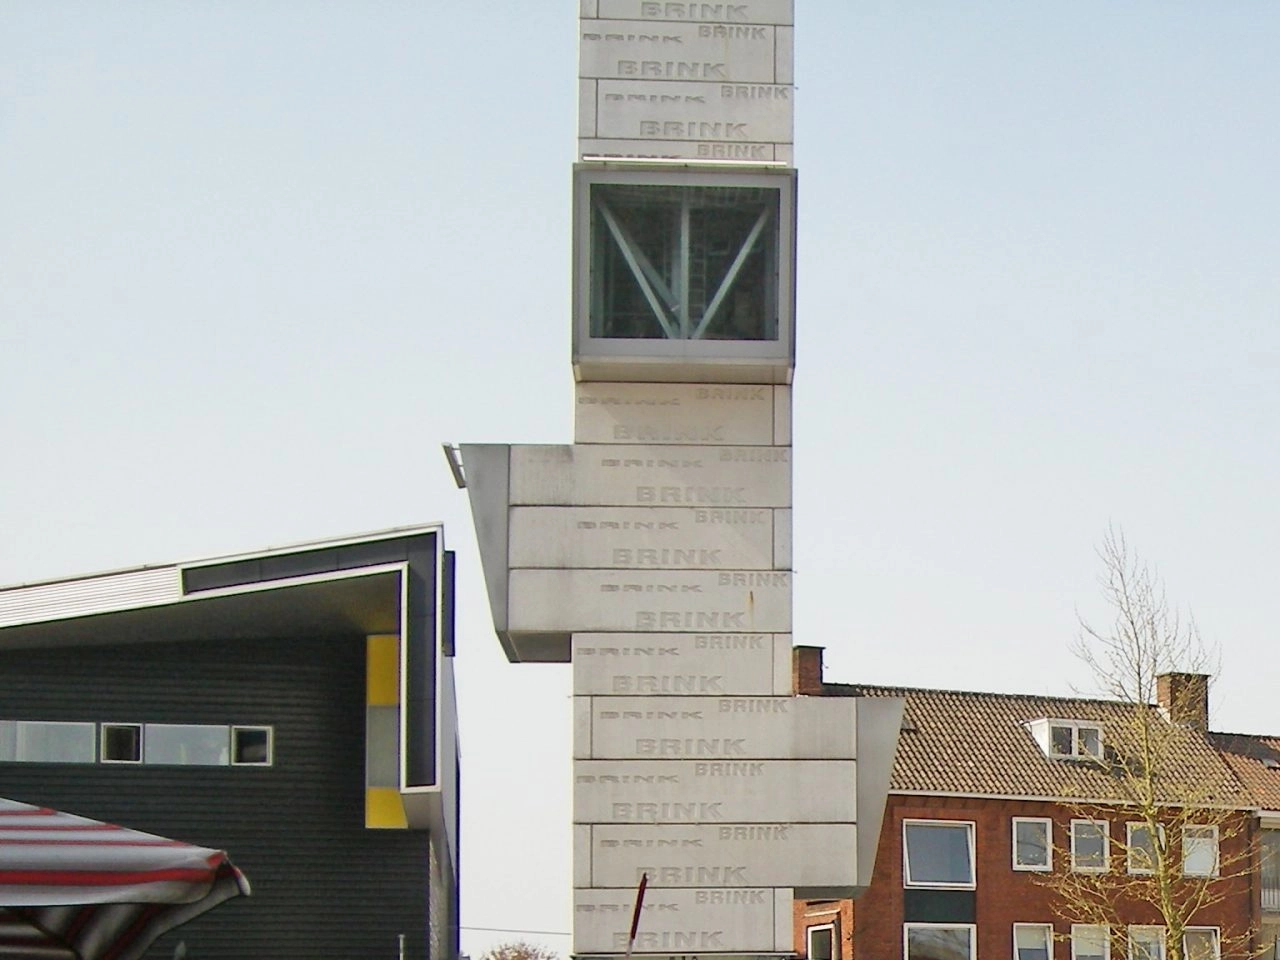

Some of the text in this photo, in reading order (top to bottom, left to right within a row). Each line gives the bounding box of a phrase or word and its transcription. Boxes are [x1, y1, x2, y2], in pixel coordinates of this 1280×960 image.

[641, 2, 749, 20] BRINK
[583, 33, 683, 43] BRINK
[698, 25, 766, 40] BRINK
[617, 60, 726, 78] BRINK
[721, 85, 789, 100] BRINK
[640, 120, 748, 138] BRINK
[697, 143, 766, 158] BRINK
[613, 425, 724, 441] BRINK
[636, 486, 747, 503] BRINK
[695, 510, 764, 524] BRINK
[613, 549, 723, 566] BRINK
[718, 573, 787, 587] BRINK
[600, 585, 703, 593] BRINK
[635, 611, 745, 628] BRINK
[695, 636, 763, 649] BRINK
[576, 648, 680, 656] BRINK
[612, 675, 722, 692] BRINK
[718, 700, 788, 713] BRINK
[600, 711, 703, 719] BRINK
[635, 738, 746, 755] BRINK
[695, 763, 764, 777] BRINK
[576, 775, 679, 783] BRINK
[611, 802, 723, 820] BRINK
[719, 826, 789, 841] BRINK
[600, 839, 703, 848] BRINK
[635, 866, 747, 884] BRINK
[695, 890, 764, 905] BRINK
[612, 931, 723, 949] BRINK
